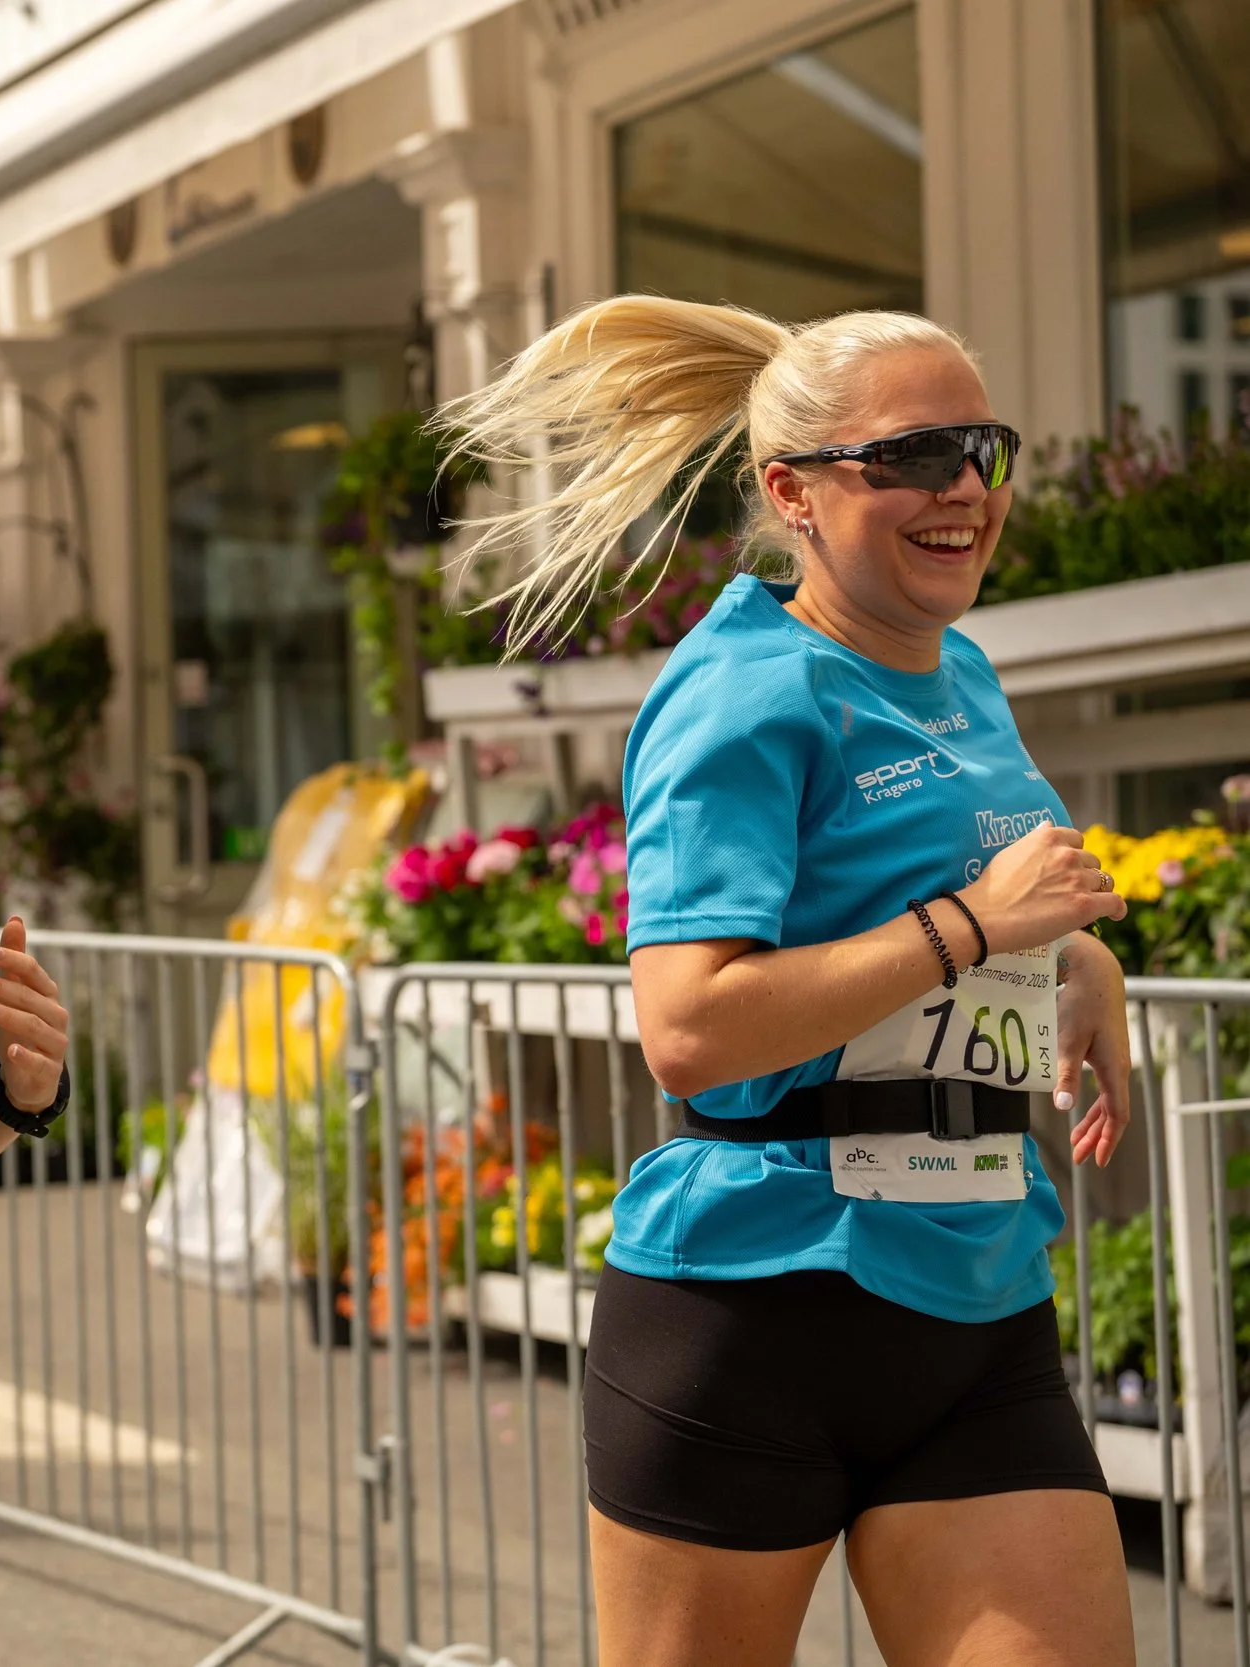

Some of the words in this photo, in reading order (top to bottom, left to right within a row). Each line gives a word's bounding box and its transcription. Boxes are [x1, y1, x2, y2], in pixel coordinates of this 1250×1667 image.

[915, 717, 953, 736] skin
[951, 712, 969, 732] AS
[855, 749, 939, 790] sport
[862, 777, 923, 805] Kragerø
[970, 966, 1026, 987] sommerløp
[1026, 973, 1050, 988] 2026
[922, 998, 1031, 1086] 160
[1037, 1023, 1049, 1037] 5
[1038, 1047, 1051, 1080] KM
[908, 1156, 958, 1171] SWML
[973, 1153, 1000, 1172] KIWI
